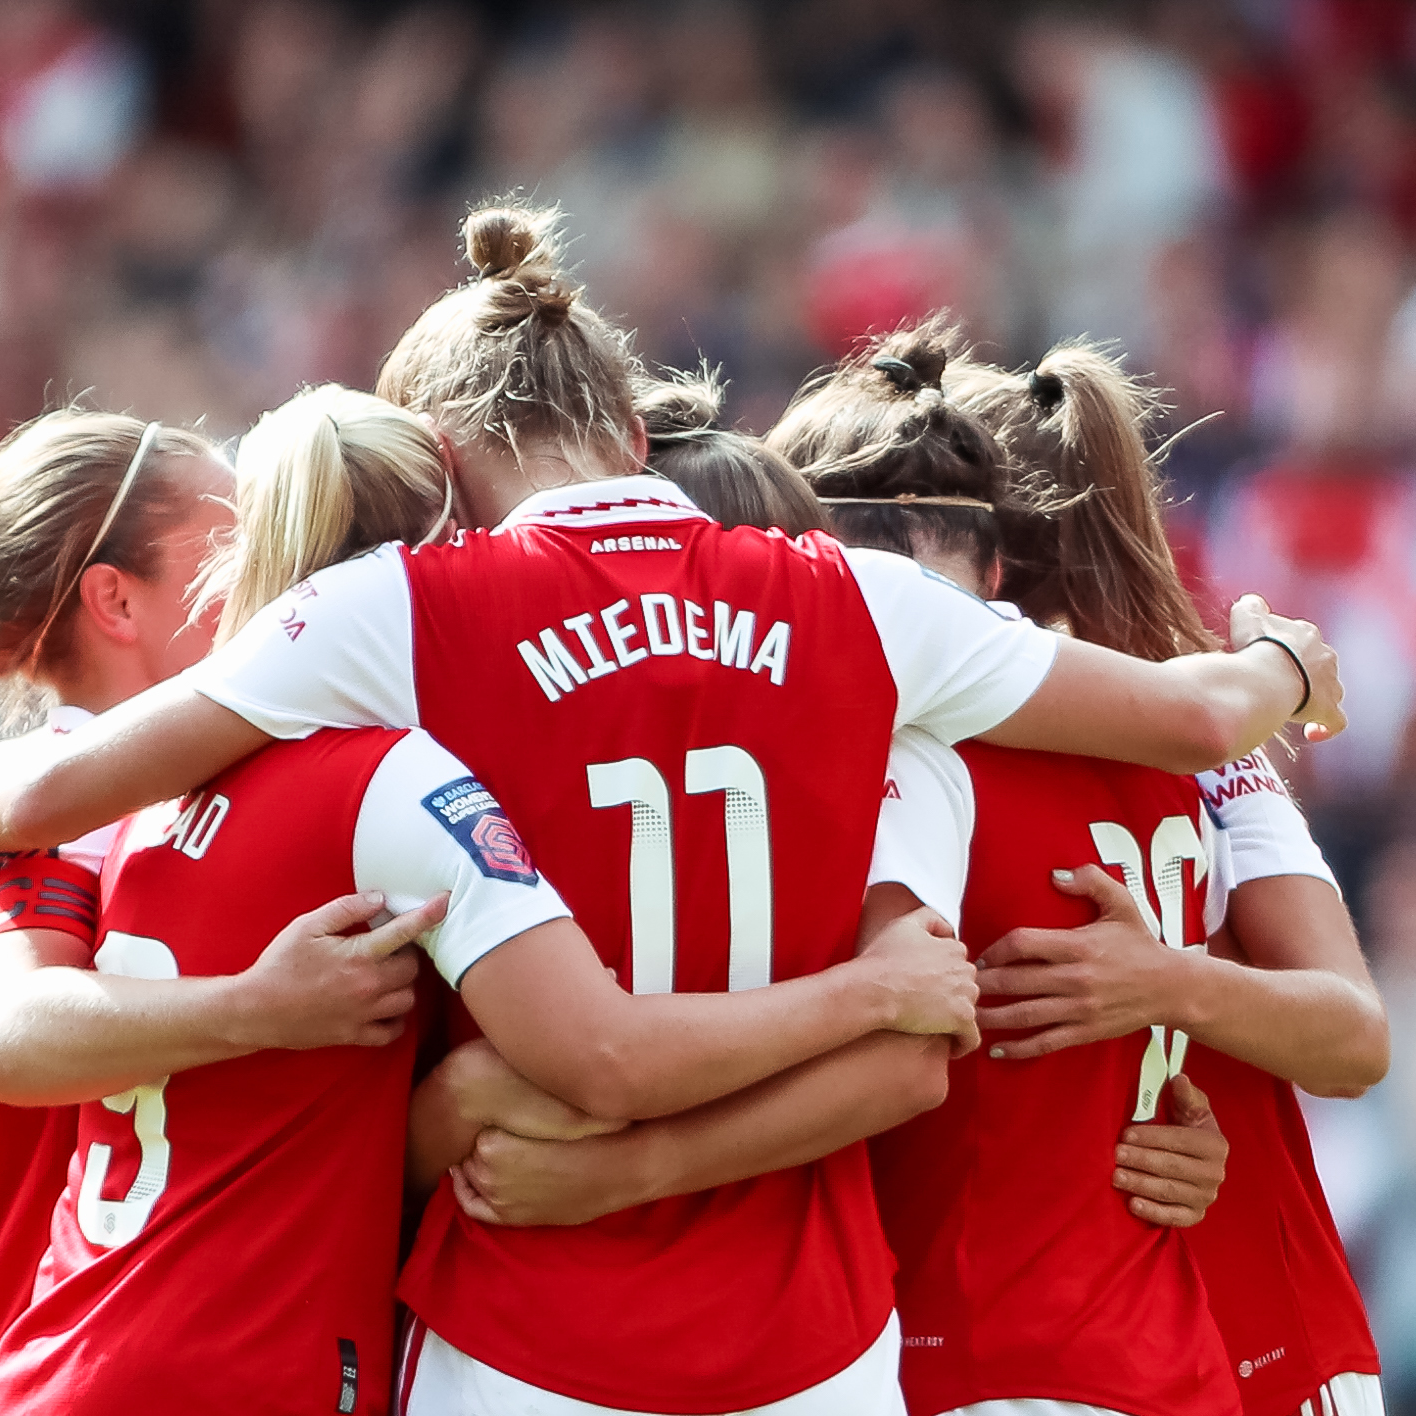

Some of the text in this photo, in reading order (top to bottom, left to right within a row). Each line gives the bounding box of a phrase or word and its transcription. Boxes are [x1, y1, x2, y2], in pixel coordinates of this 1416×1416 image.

[591, 536, 682, 553] ARSENAL
[516, 593, 791, 702] MIEDEMA
[443, 782, 486, 800] BARCLA
[1204, 773, 1285, 808] WAND
[162, 791, 230, 861] AD
[587, 745, 773, 995] 11
